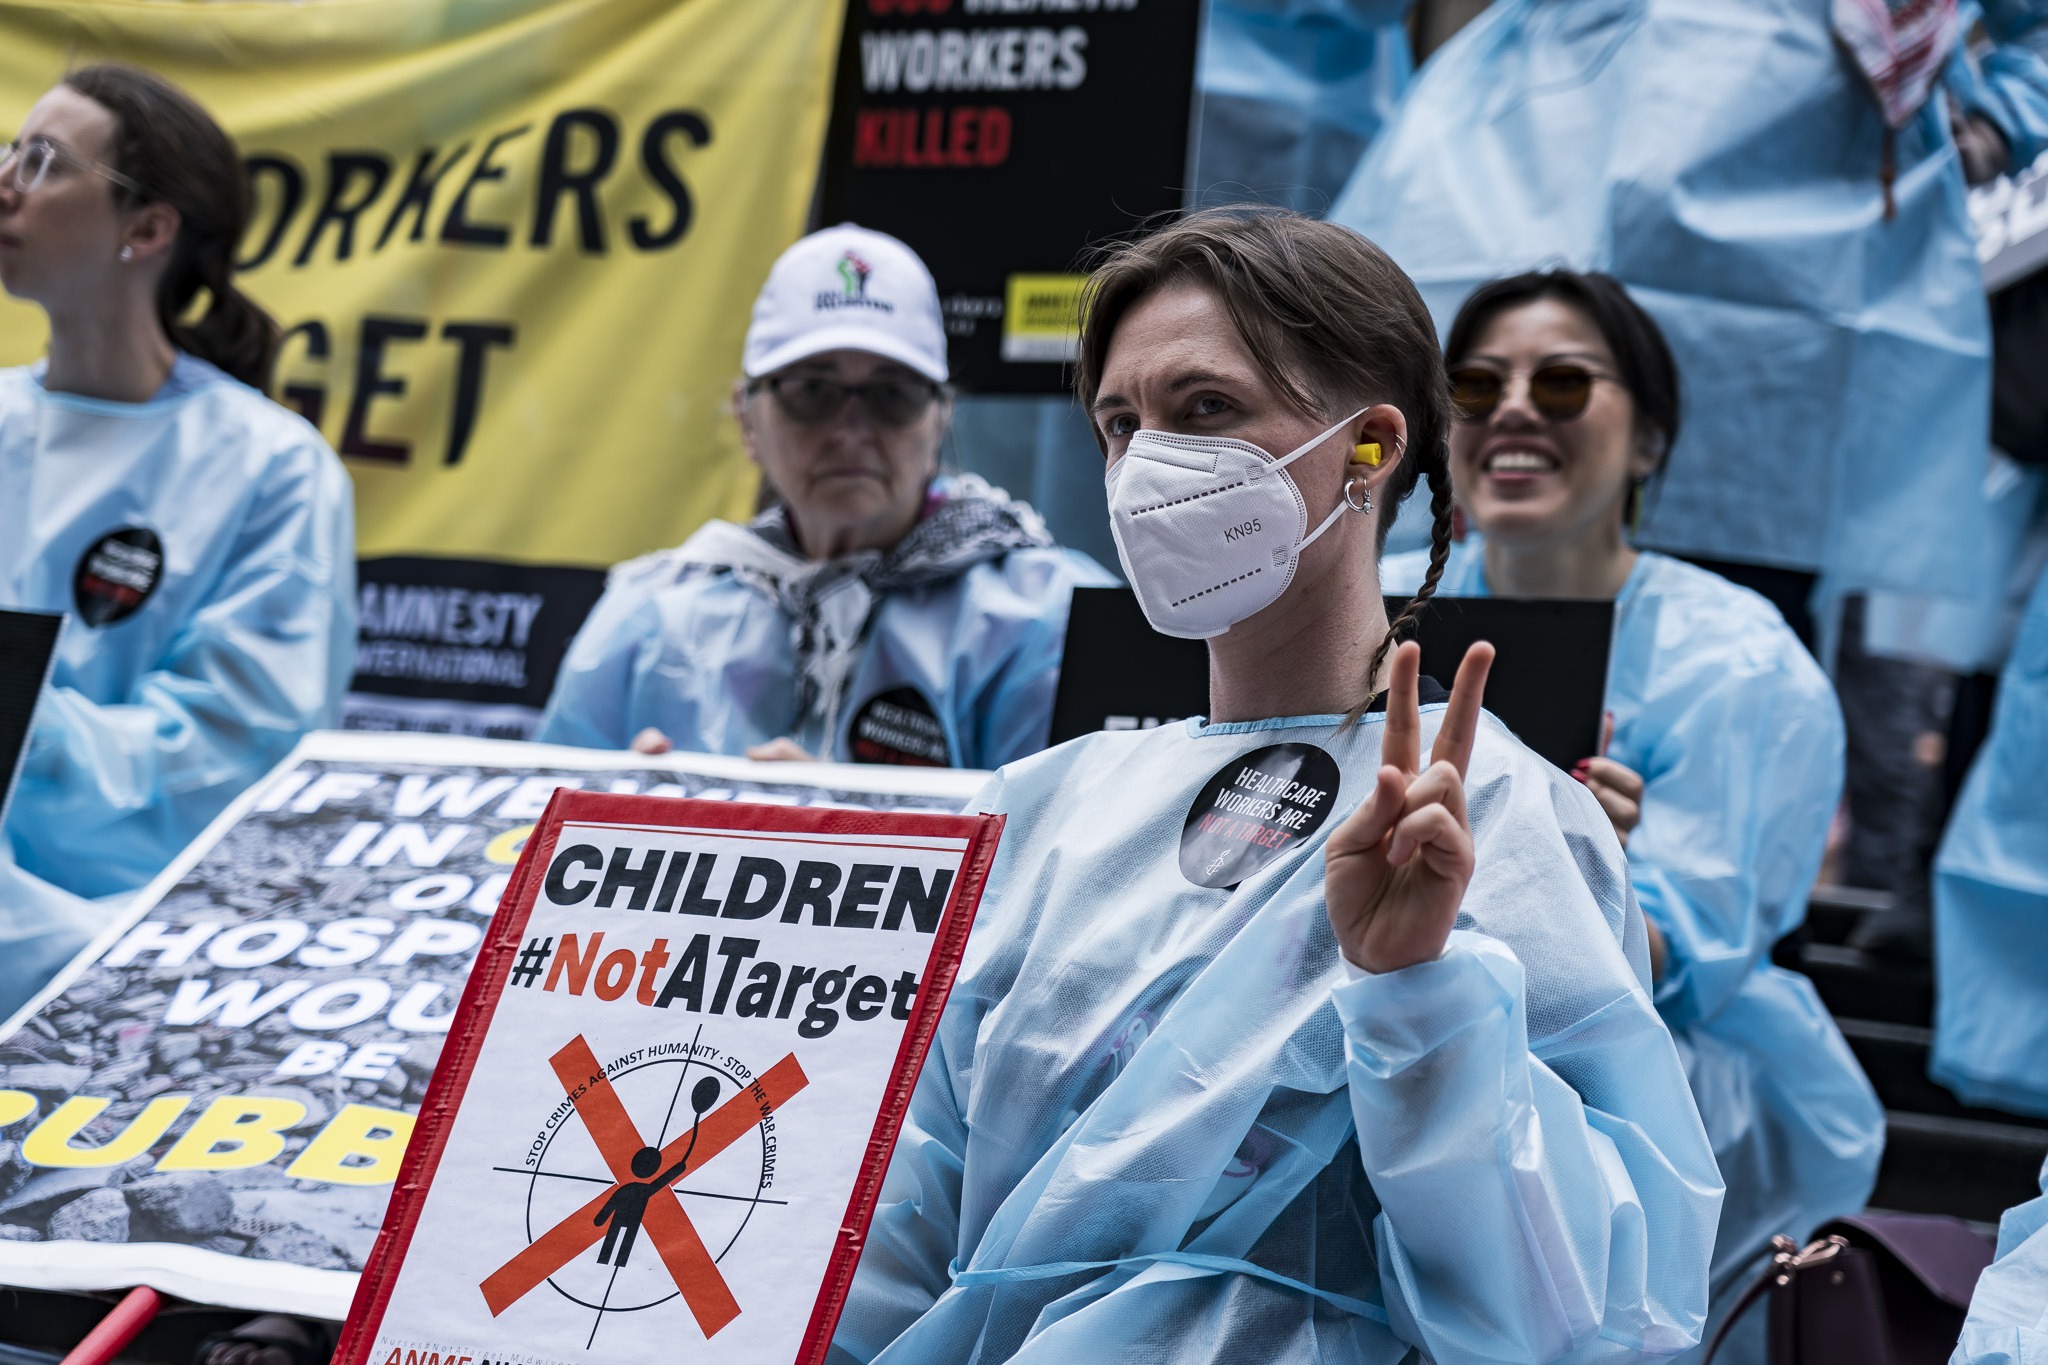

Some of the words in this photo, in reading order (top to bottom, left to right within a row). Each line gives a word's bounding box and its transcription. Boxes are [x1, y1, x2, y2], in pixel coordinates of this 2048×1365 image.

[860, 27, 1089, 91] WORKERS
[854, 107, 1012, 165] KILLED
[1224, 518, 1262, 543] KN95
[357, 582, 544, 647] AMNESTY
[252, 771, 382, 814] IF
[392, 775, 586, 819] WE
[1214, 787, 1281, 820] WORKERS
[1275, 808, 1312, 830] ARE
[1234, 766, 1327, 808] HEALTHCARE
[324, 822, 471, 867] IN
[1197, 813, 1230, 834] NOT
[1223, 819, 1239, 837] A
[1236, 822, 1292, 850] TARGET
[544, 843, 955, 935] CHILDREN
[102, 917, 483, 973] HOSP
[510, 931, 921, 1039] #NotATarget
[275, 1040, 411, 1080] BE
[589, 1048, 645, 1087] AGAINST
[648, 1043, 720, 1060] HUMANITY
[723, 1056, 752, 1080] STOP
[545, 1083, 587, 1129] CRIMES
[748, 1077, 767, 1104] THE
[760, 1101, 776, 1135] WAR
[525, 1131, 547, 1167] STOP
[761, 1136, 777, 1189] CRIMES
